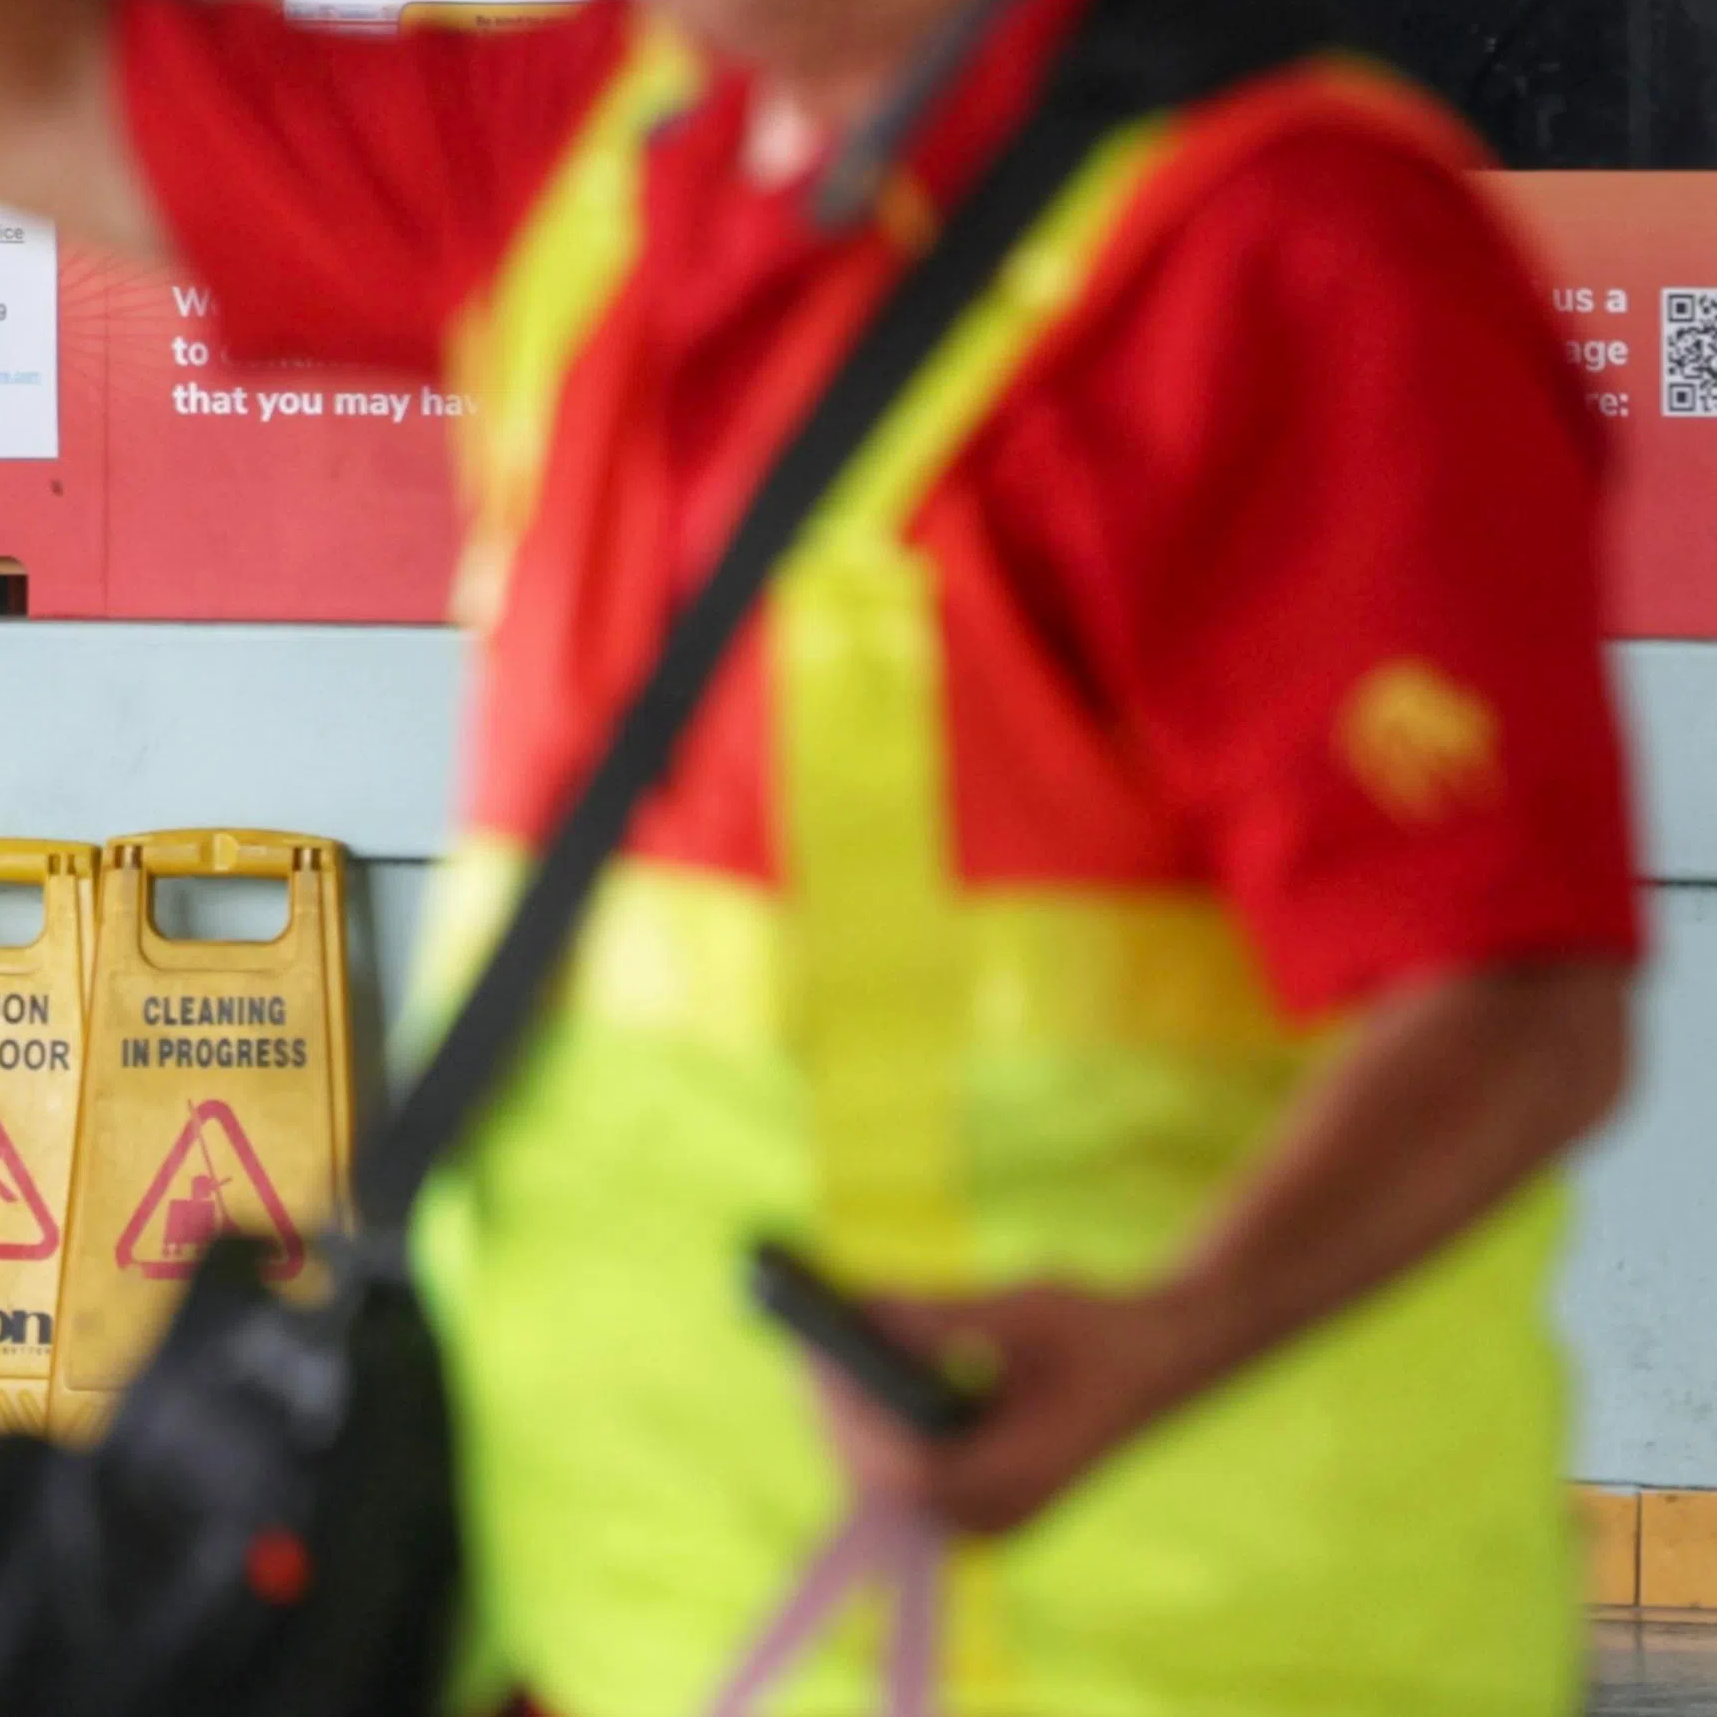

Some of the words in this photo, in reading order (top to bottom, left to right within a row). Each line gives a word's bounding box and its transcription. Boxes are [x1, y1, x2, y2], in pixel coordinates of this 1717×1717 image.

[1552, 288, 1595, 313] us
[1604, 288, 1629, 313] a
[172, 336, 209, 367] to
[1566, 340, 1629, 372] age
[172, 381, 248, 415] that
[257, 389, 323, 423] you
[334, 390, 411, 423] may
[421, 385, 480, 416] hav
[142, 995, 287, 1028] CLEANING
[122, 1038, 150, 1068] IN
[158, 1038, 307, 1070] PROGRESS
